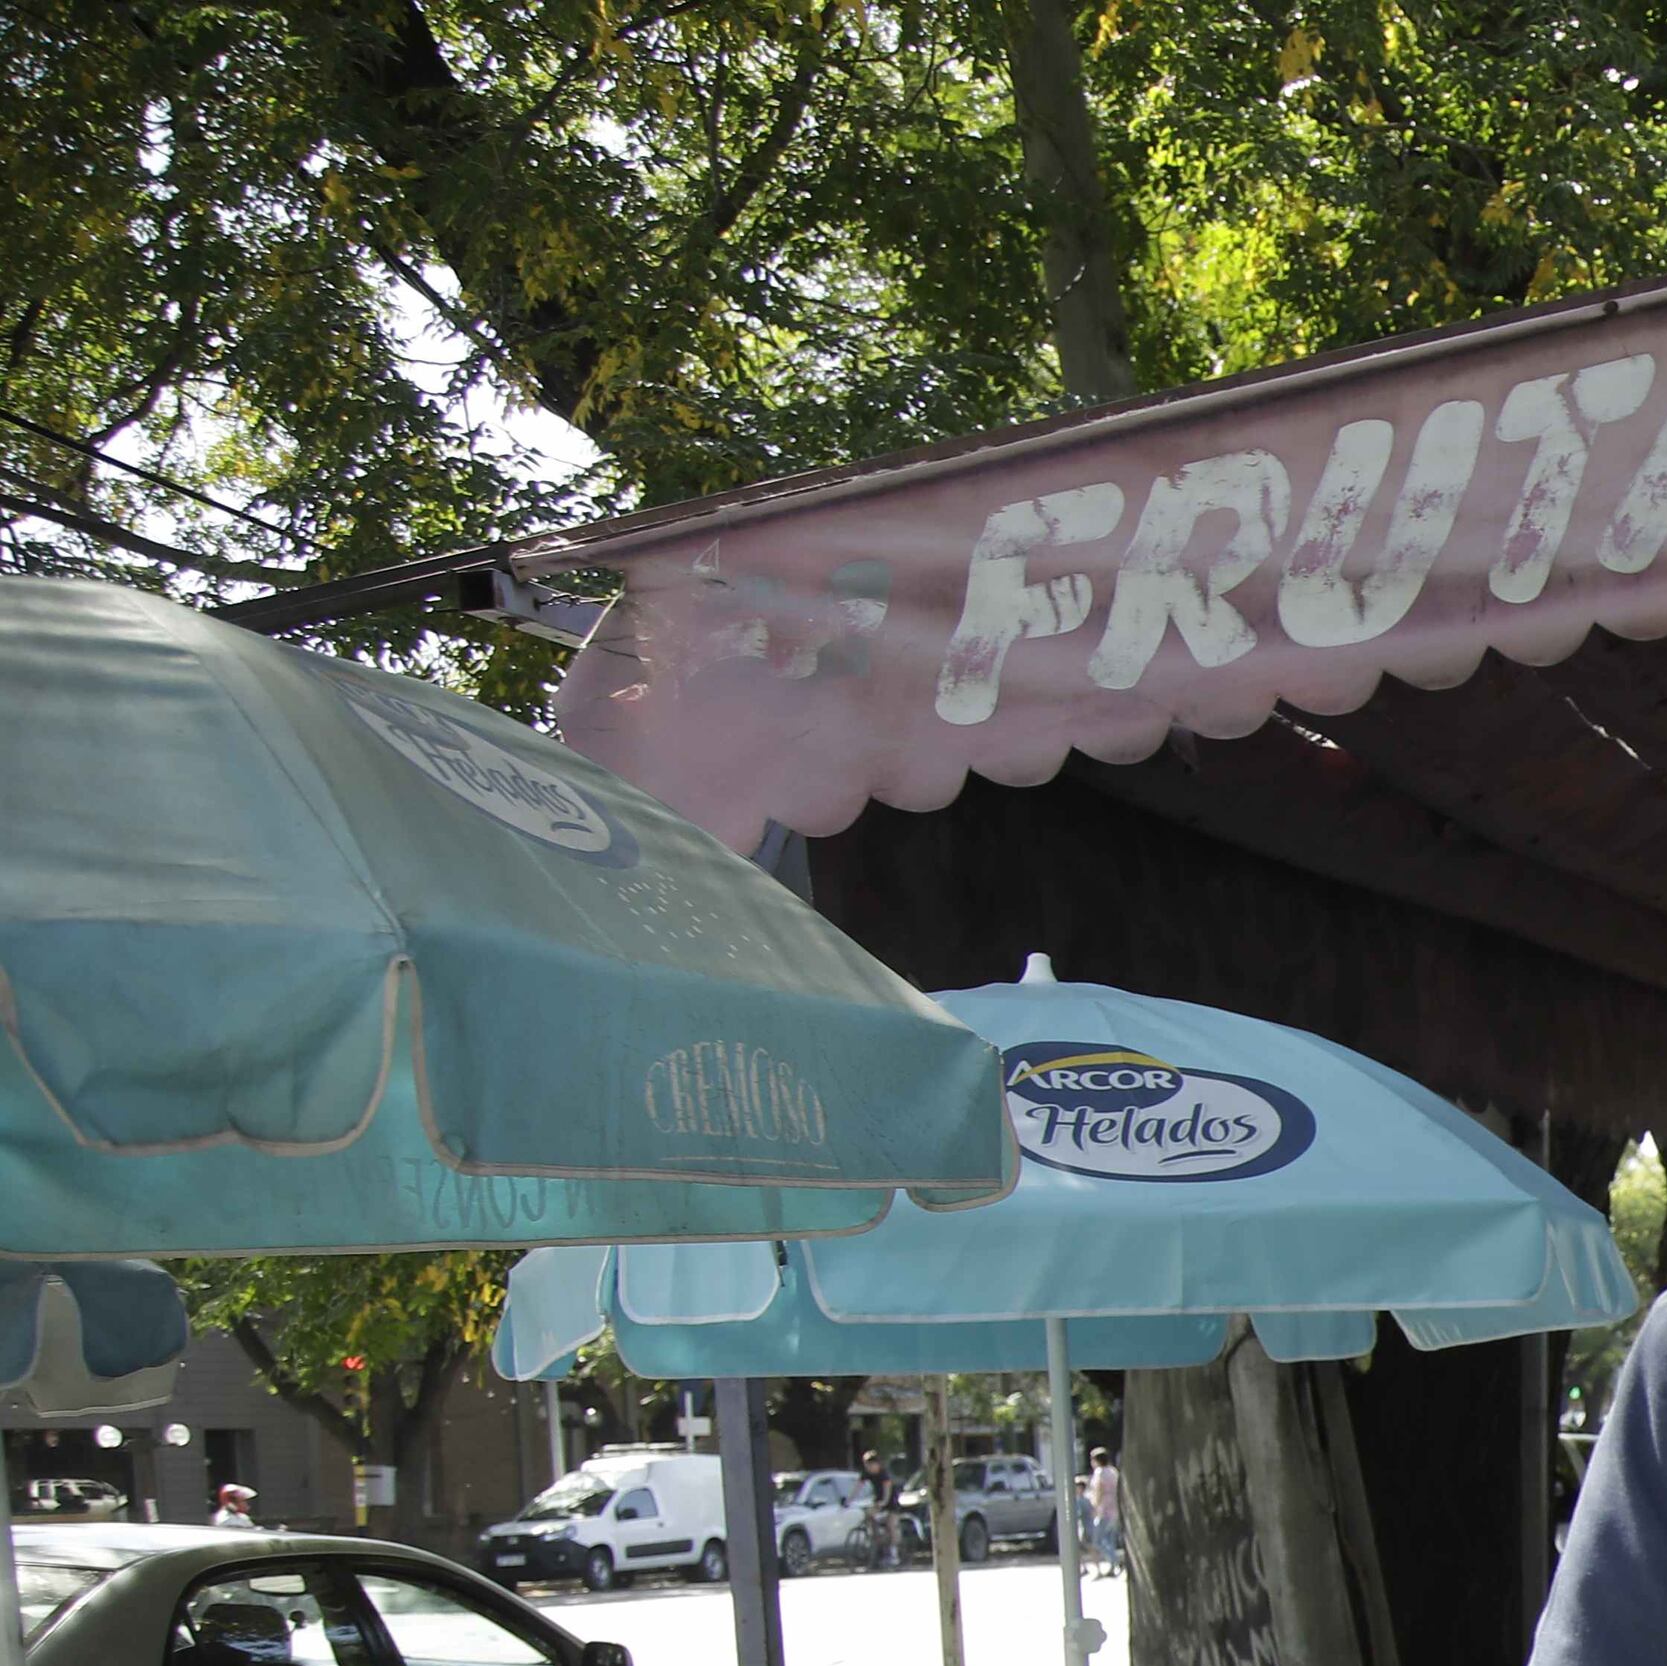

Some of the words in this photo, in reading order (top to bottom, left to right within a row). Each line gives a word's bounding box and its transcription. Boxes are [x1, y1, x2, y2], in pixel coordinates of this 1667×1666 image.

[644, 1039, 829, 1146] CREMOSO
[1007, 1060, 1177, 1090] ARCOR
[1025, 1103, 1257, 1151] Helados
